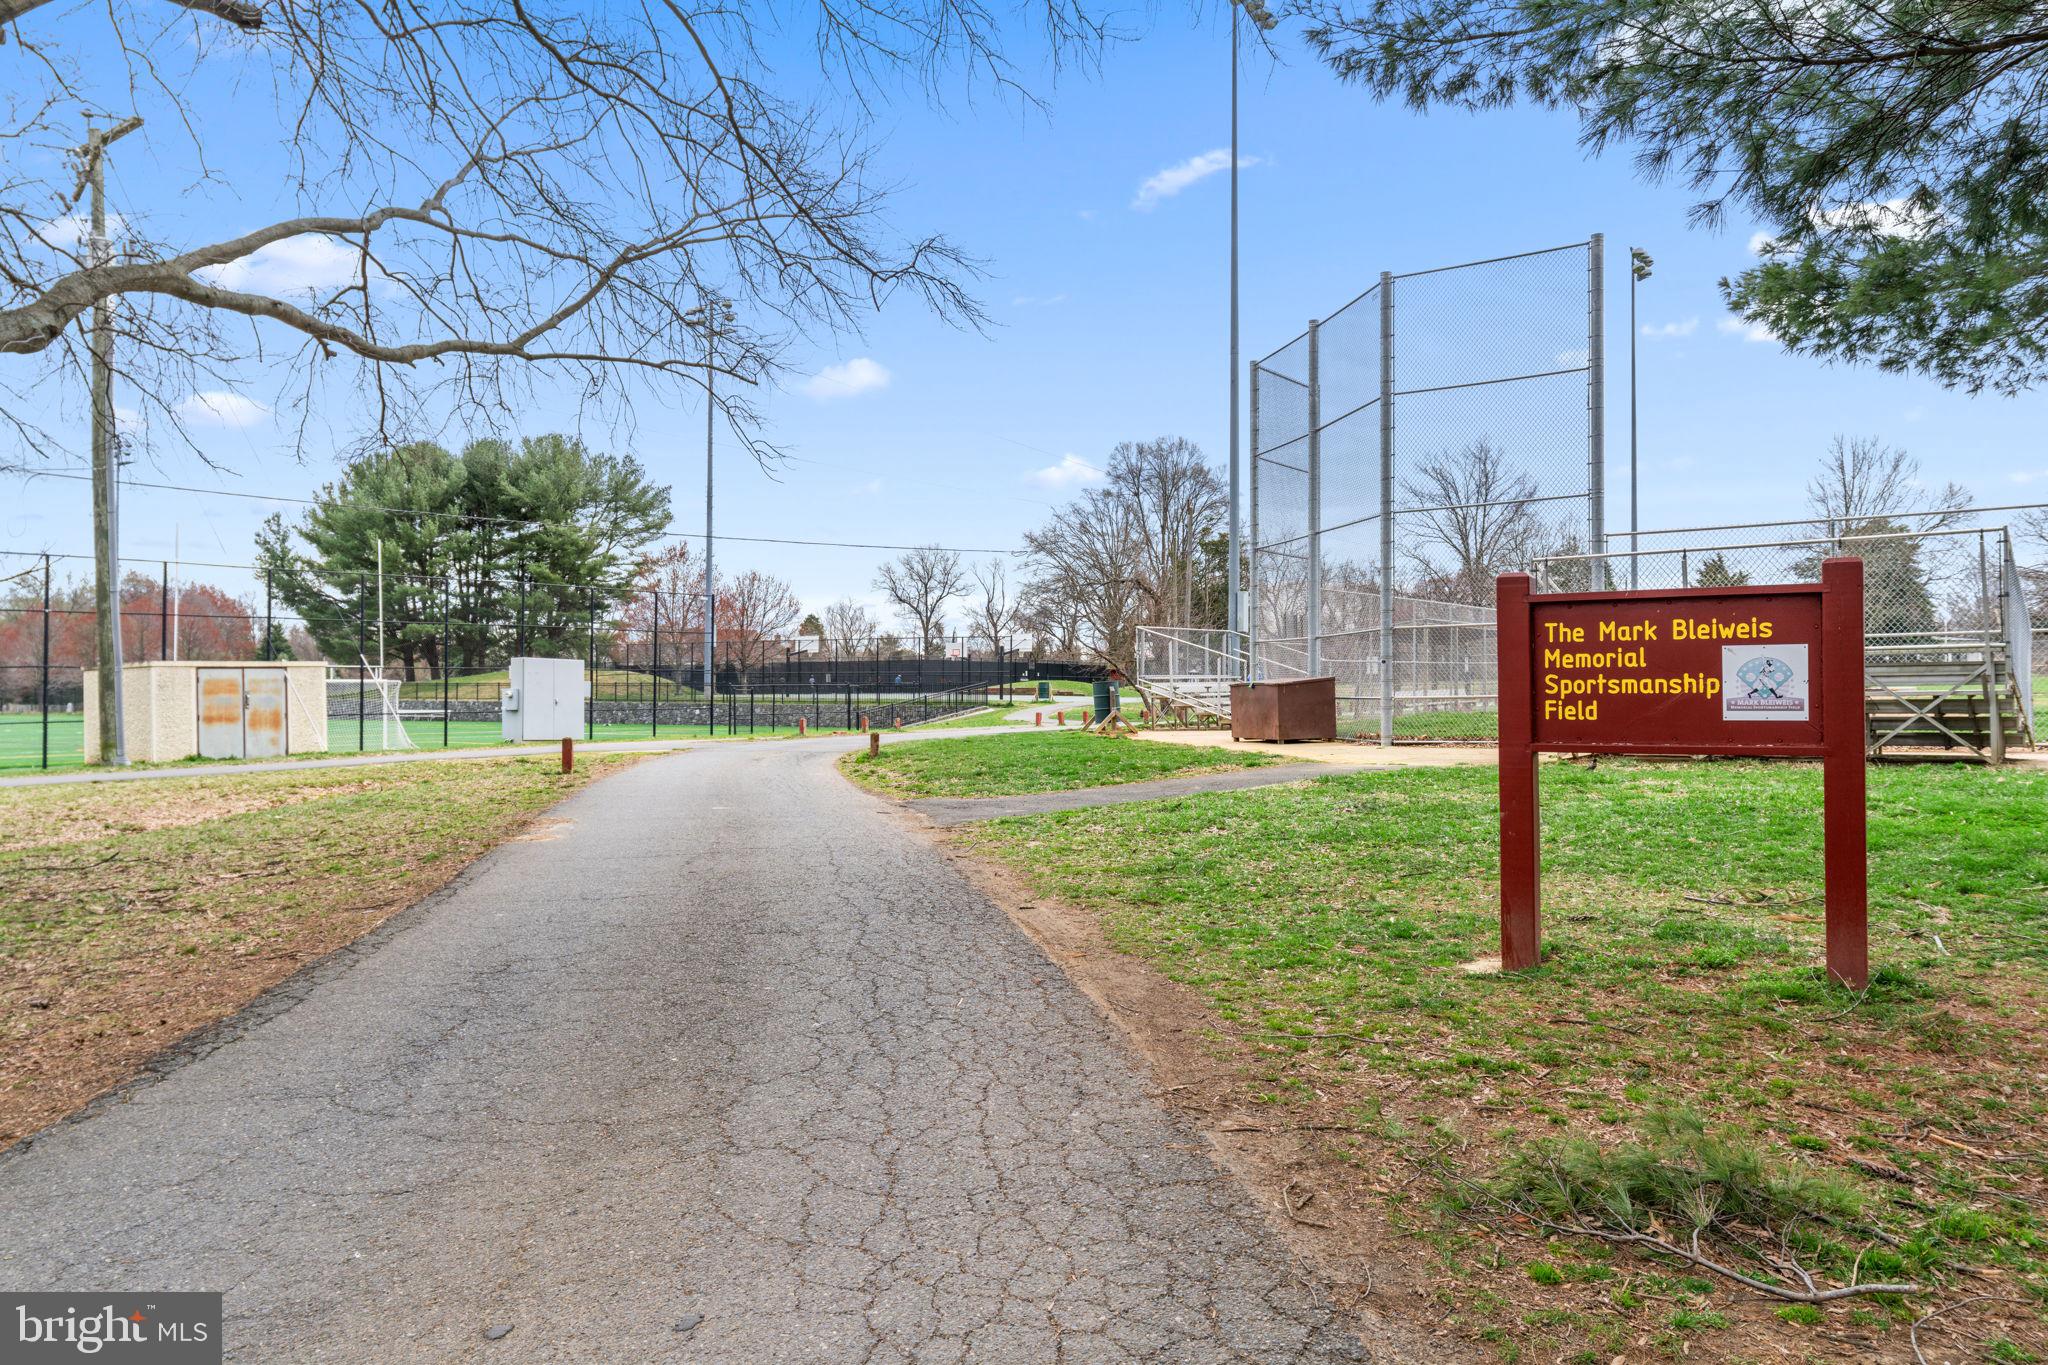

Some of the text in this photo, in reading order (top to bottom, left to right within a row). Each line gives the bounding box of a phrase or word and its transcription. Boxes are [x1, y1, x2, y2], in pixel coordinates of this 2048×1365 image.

[1544, 616, 1773, 643] The Mark Bleiweis
[1544, 646, 1647, 669] Memorial
[1544, 672, 1720, 700] Sportsmanship
[1544, 699, 1598, 721] Field
